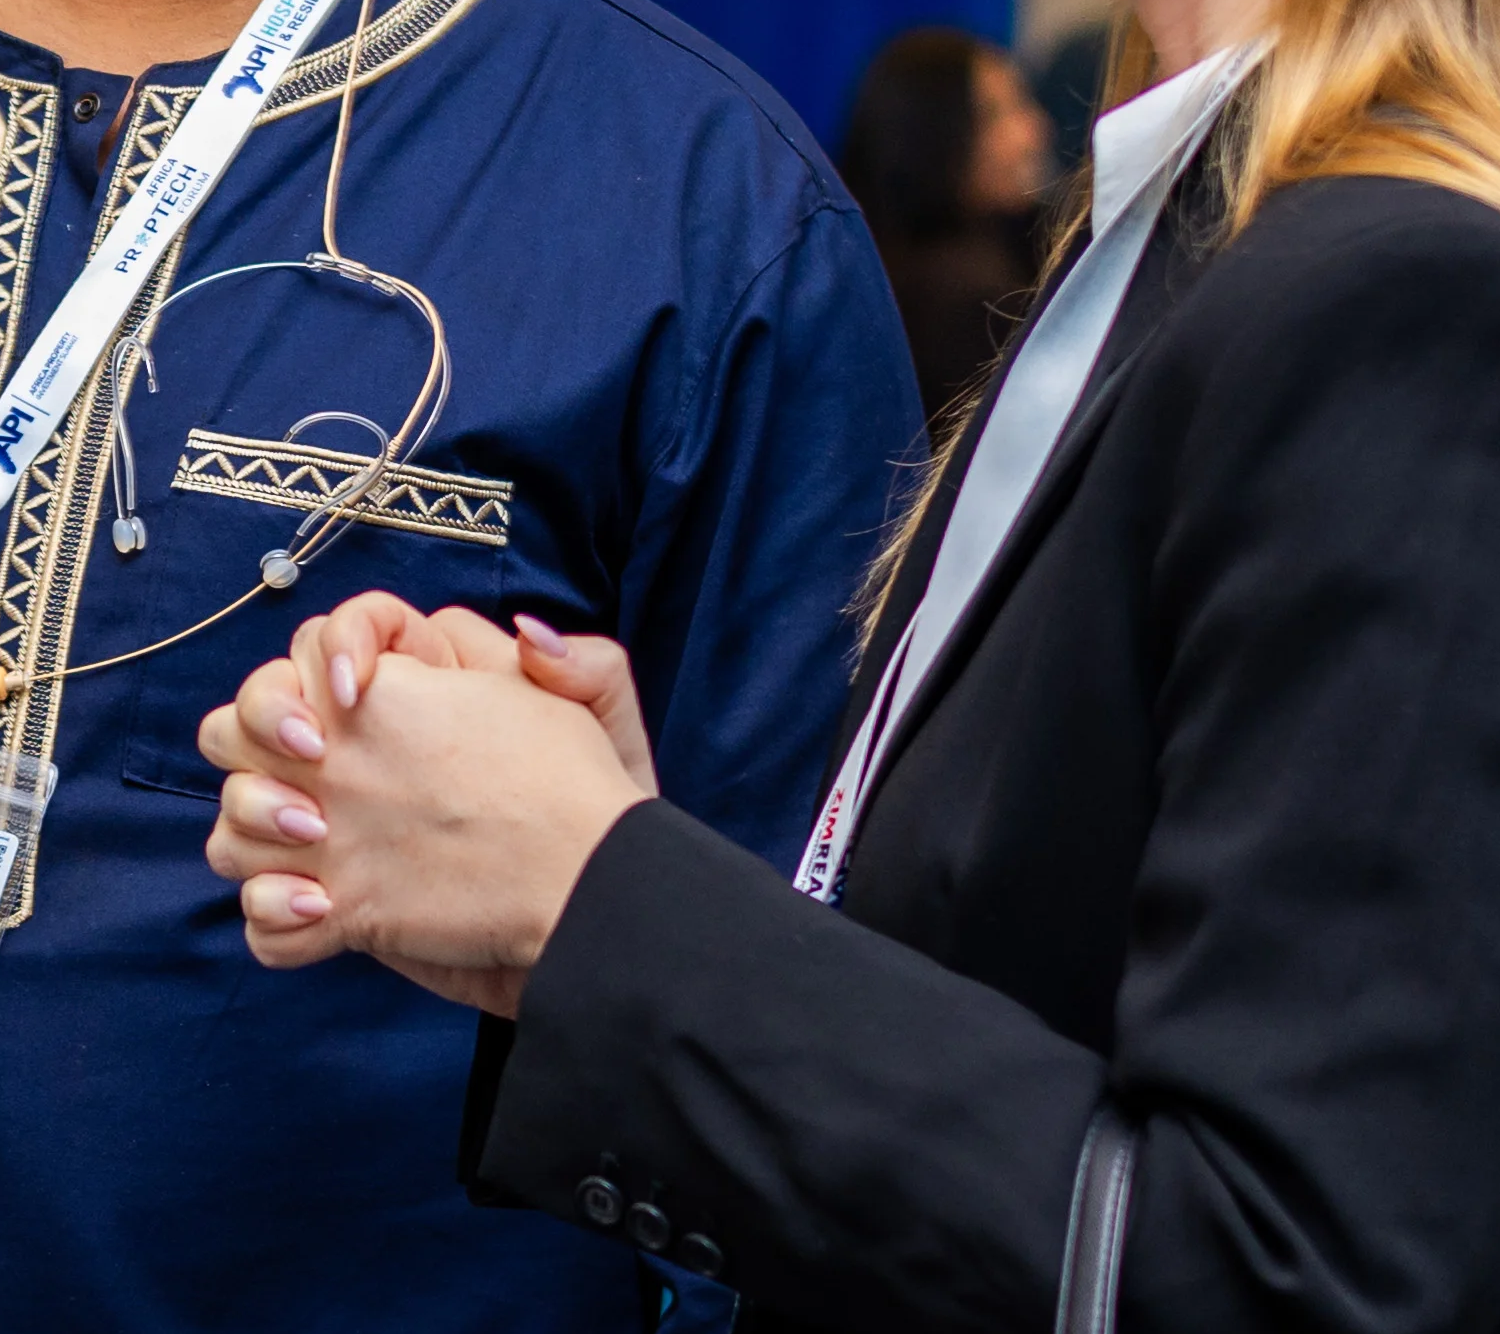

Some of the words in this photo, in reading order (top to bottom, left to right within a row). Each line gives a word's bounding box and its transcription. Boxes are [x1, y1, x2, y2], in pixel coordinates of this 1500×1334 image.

[279, 32, 291, 42] &
[241, 44, 275, 80] API
[146, 158, 179, 198] AFRICA
[177, 172, 211, 214] FORUM
[28, 367, 48, 396] AFRICA
[45, 331, 71, 369] PROPERTY
[807, 788, 843, 894] ZIMREA
